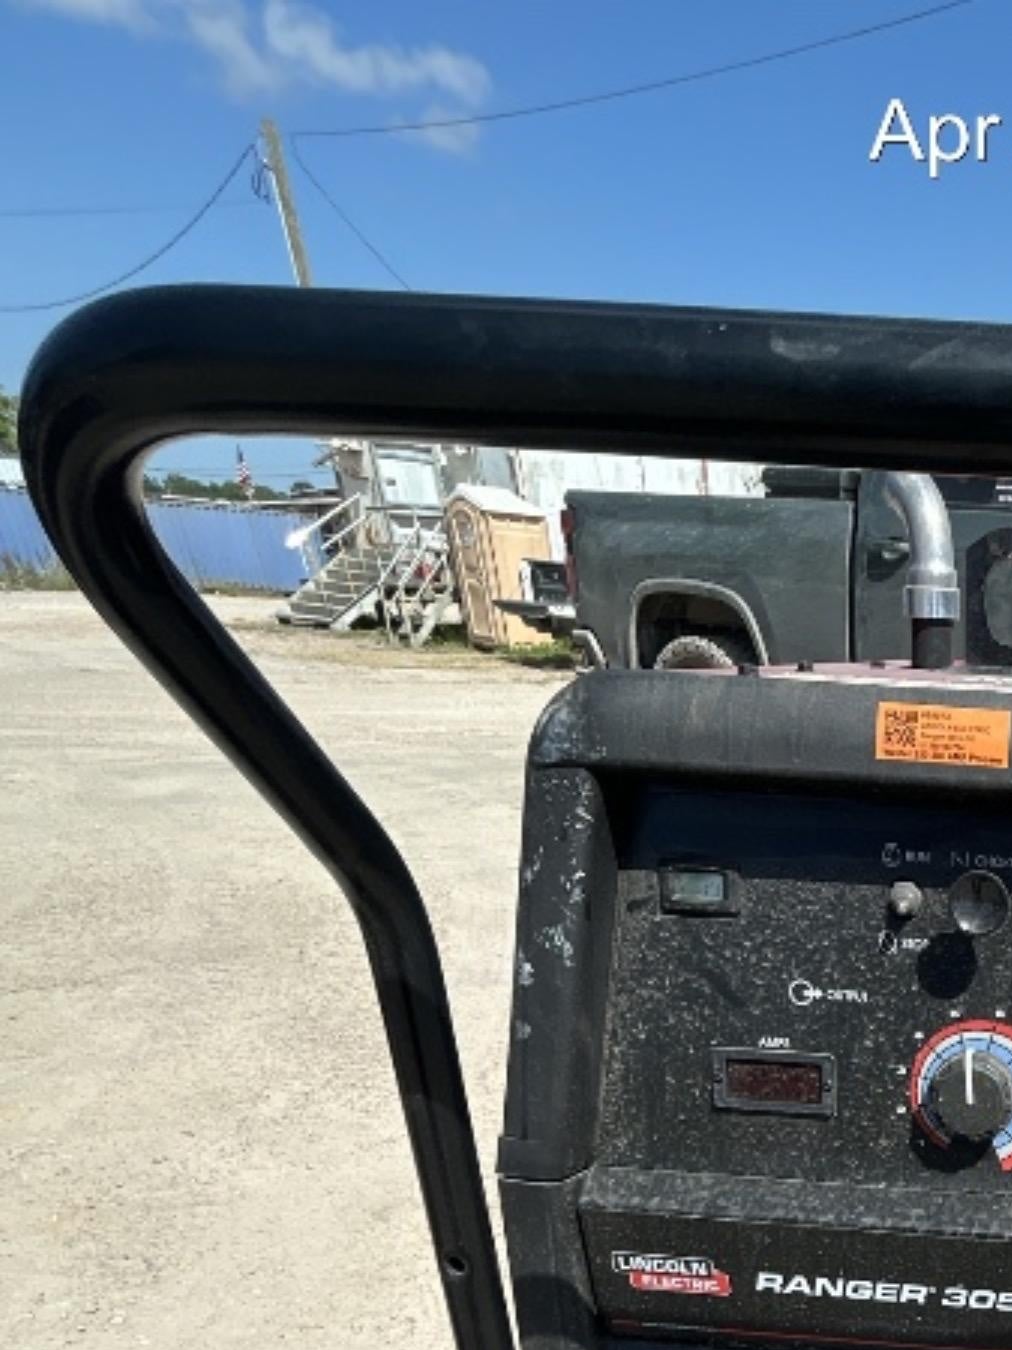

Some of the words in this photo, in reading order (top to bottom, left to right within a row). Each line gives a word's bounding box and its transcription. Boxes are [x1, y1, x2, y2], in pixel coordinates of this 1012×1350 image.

[758, 1035, 791, 1049] AMPS
[617, 1254, 709, 1277] LINCOLN
[640, 1273, 722, 1292] ELECTRIC
[754, 1270, 928, 1305] RANGER
